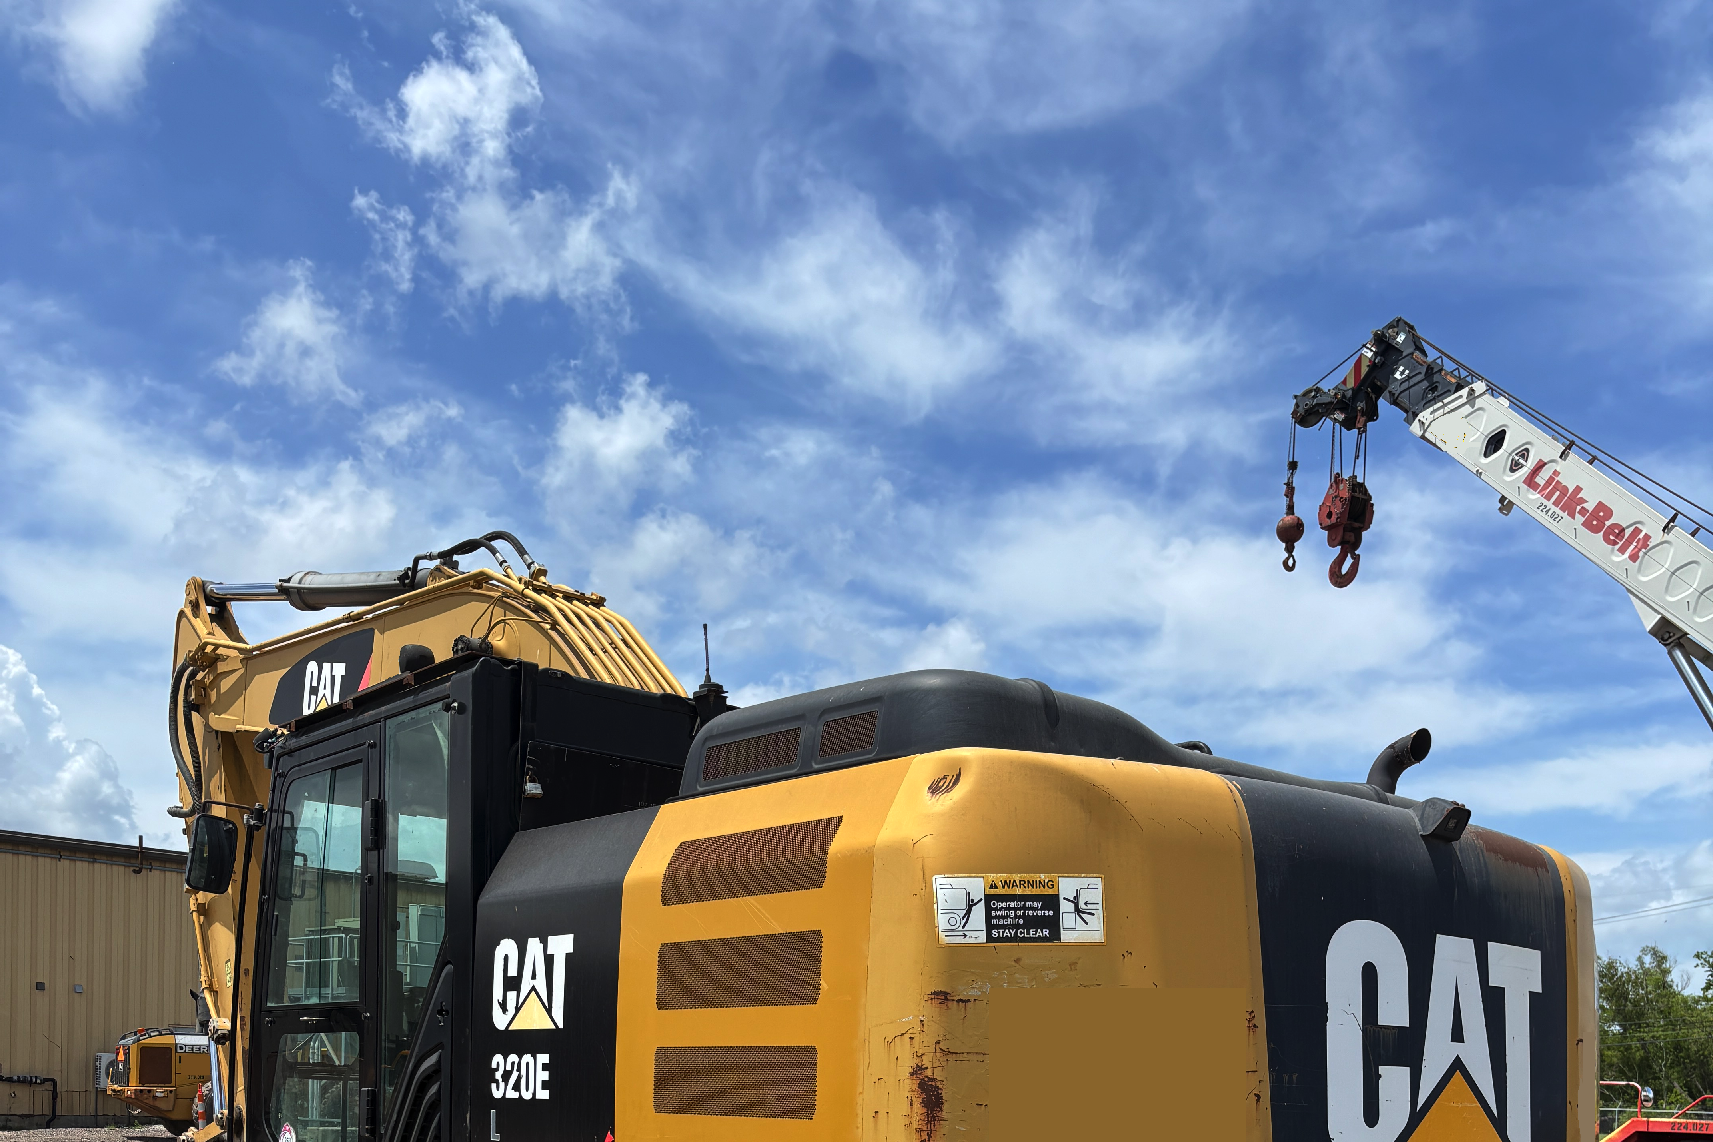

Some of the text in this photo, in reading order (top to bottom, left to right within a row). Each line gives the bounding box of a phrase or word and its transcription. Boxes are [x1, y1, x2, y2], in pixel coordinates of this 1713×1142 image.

[1522, 458, 1652, 564] Link-Belt
[1536, 501, 1564, 524] 224.027
[302, 660, 346, 716] CAT
[1000, 879, 1055, 890] WARNING
[990, 900, 1042, 909] Operator may
[991, 909, 1014, 917] swing
[991, 917, 1024, 925] machine
[991, 929, 1050, 938] STAY CLEAR
[491, 933, 575, 1031] CAT
[177, 1043, 210, 1054] DEER
[490, 1053, 550, 1100] 320E
[490, 1109, 501, 1142] L
[1670, 1121, 1710, 1132] 224.027
